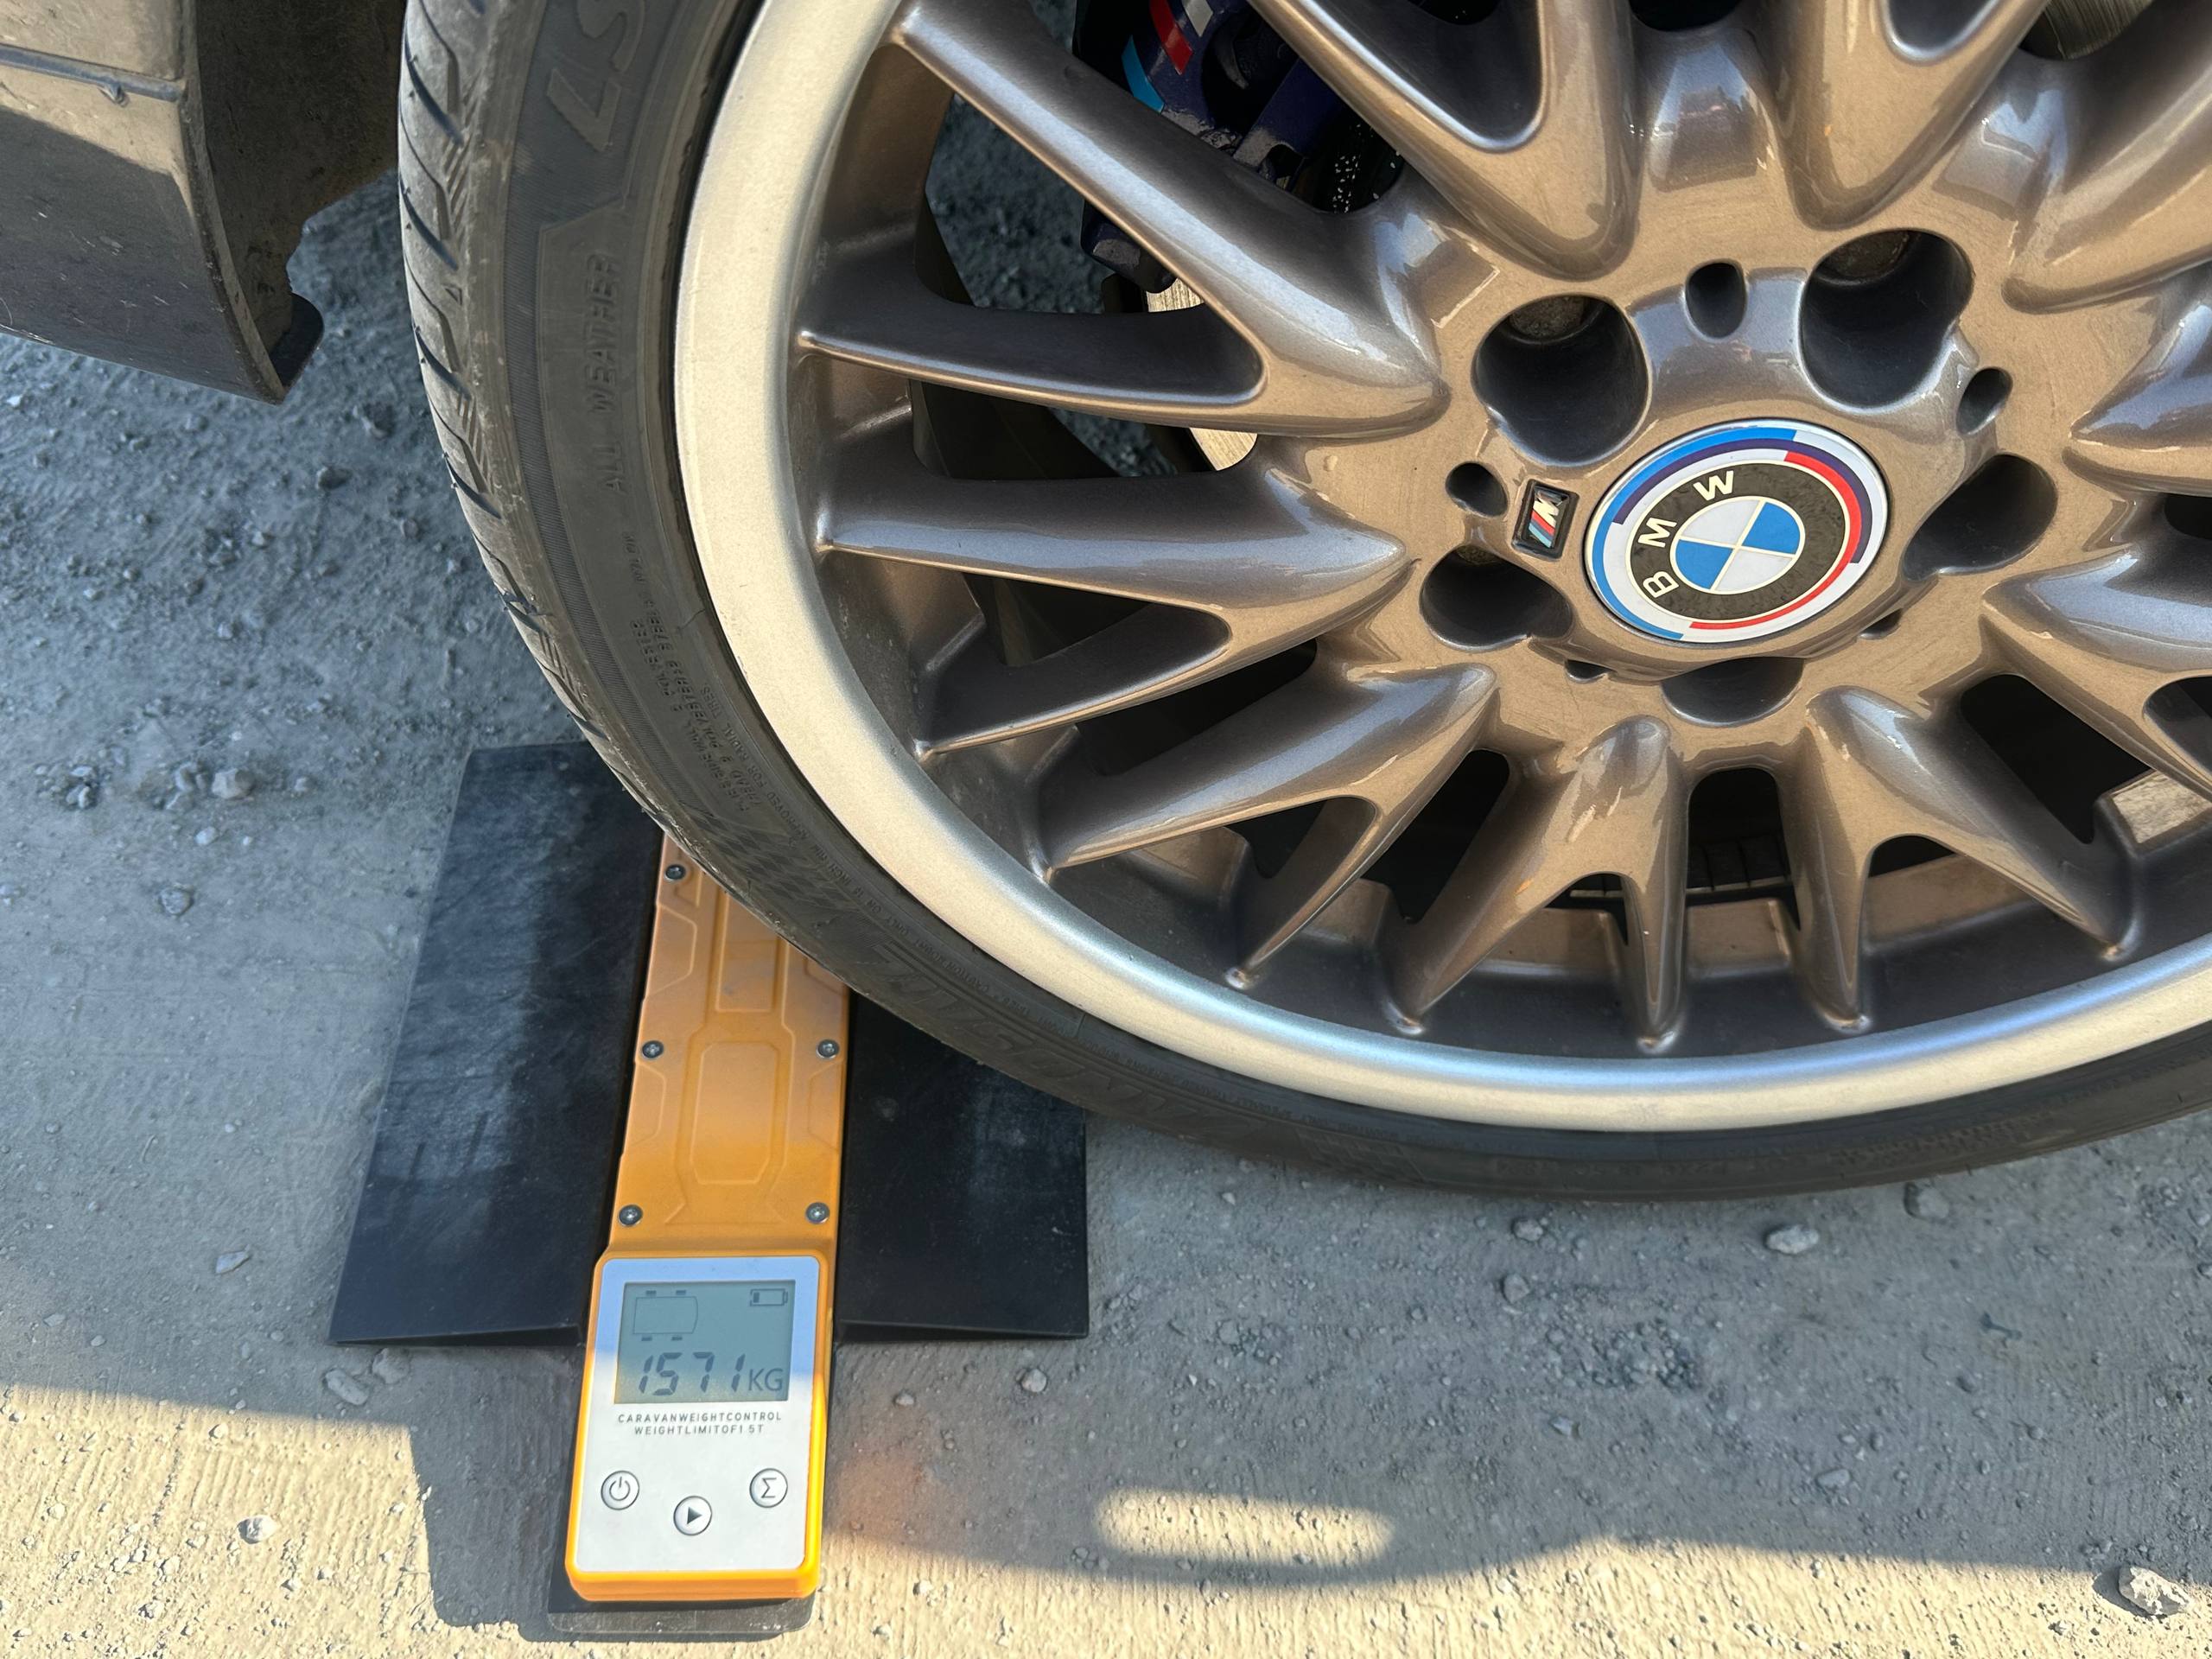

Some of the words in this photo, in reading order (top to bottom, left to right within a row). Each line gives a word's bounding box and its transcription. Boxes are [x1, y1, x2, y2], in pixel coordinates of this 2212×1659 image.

[583, 249, 620, 413] WEATHER
[592, 442, 627, 494] ALL
[1639, 471, 1734, 598] BMW
[719, 721, 750, 763] RADIAL
[746, 763, 767, 788] FOR
[638, 1351, 746, 1396] 1571
[747, 1367, 784, 1392] KG
[617, 1411, 782, 1423] CARAVANWEIGHTCONTROL
